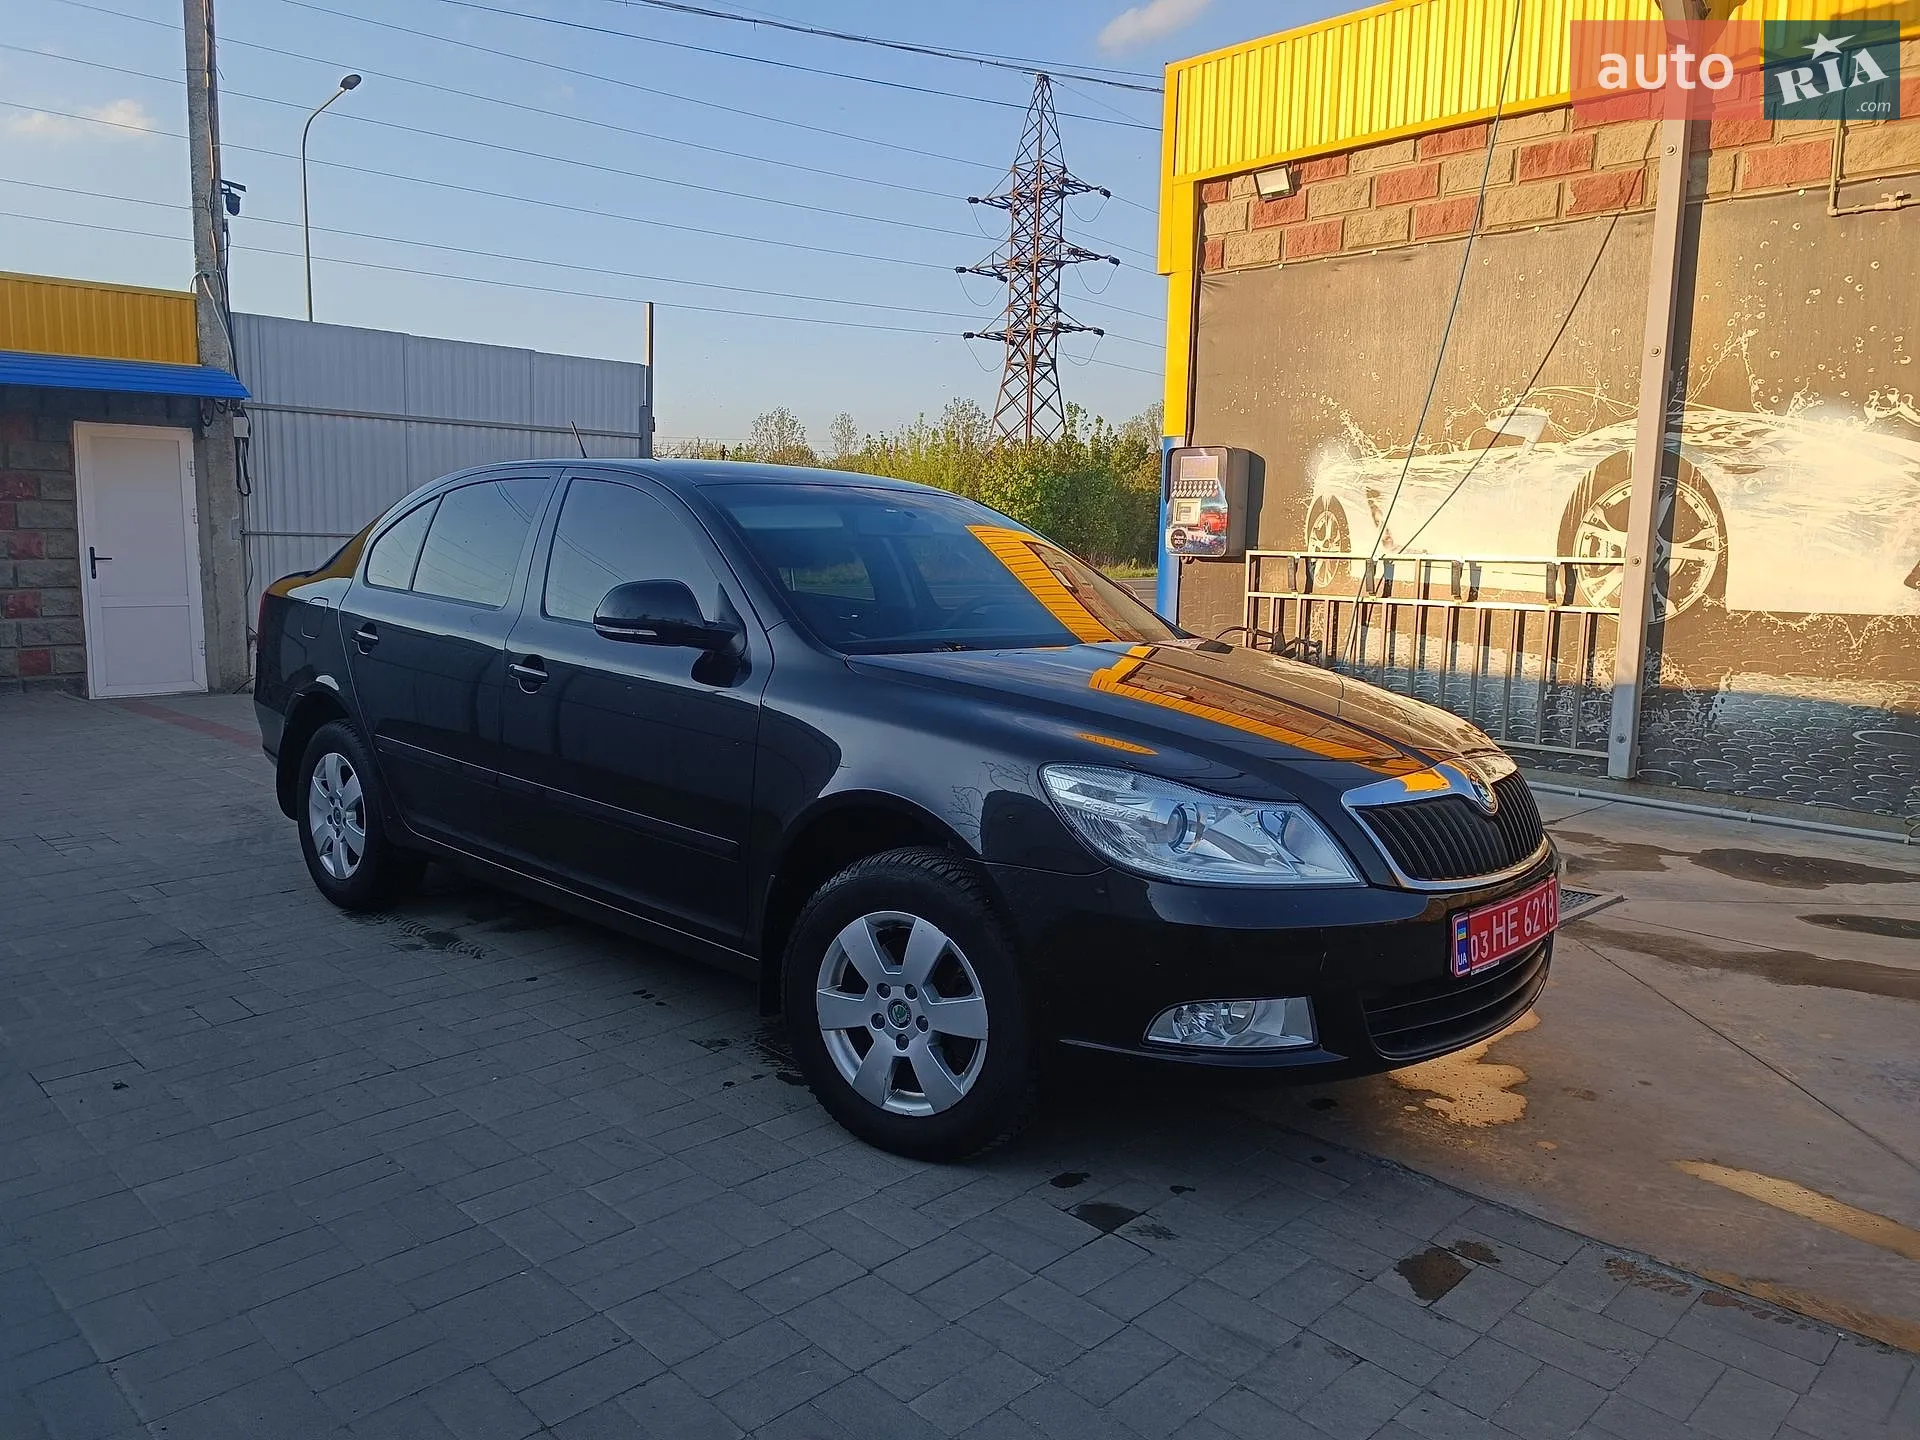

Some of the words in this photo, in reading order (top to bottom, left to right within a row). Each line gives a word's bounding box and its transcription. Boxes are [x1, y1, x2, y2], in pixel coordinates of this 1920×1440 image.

[1470, 930, 1489, 962] 03
[1492, 906, 1519, 952] HE
[1524, 889, 1555, 937] 6218
[1457, 952, 1468, 966] UA
